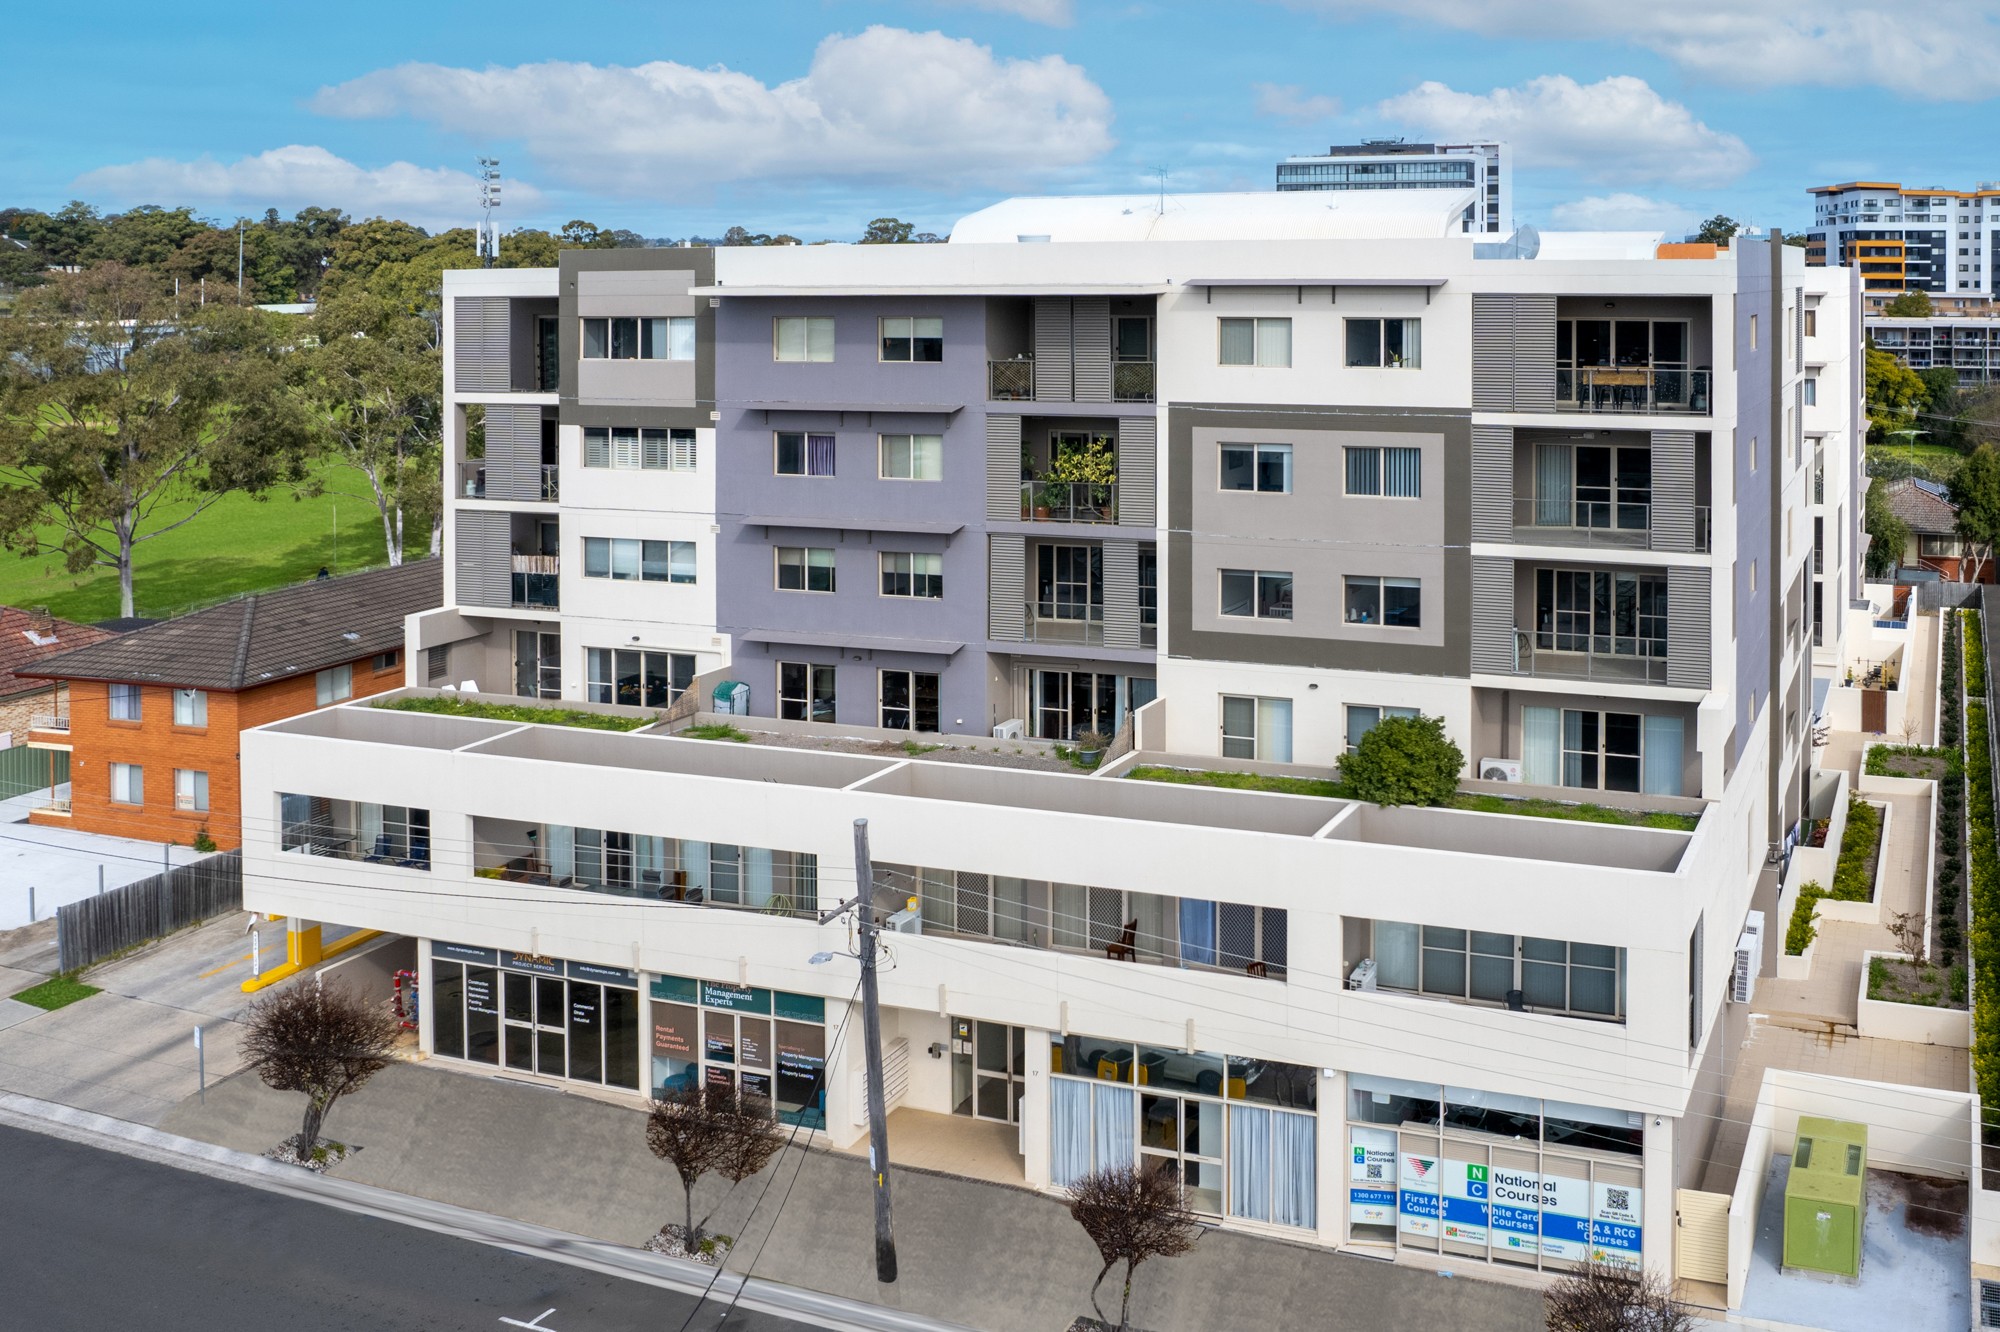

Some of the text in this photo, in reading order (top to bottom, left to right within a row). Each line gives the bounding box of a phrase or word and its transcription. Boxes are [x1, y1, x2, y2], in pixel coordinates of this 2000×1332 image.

[533, 964, 555, 972] SERVICES
[706, 980, 719, 988] The
[705, 986, 753, 1001] Management
[705, 995, 733, 1007] Experts
[655, 1025, 674, 1033] Rental
[655, 1033, 684, 1043] Payments
[655, 1041, 690, 1052] Guaranteed
[781, 1051, 824, 1062] Property Management
[781, 1060, 798, 1069] Property
[781, 1069, 814, 1080] Property Leasing
[1472, 1167, 1483, 1180] N
[1494, 1173, 1557, 1193] National
[1471, 1183, 1483, 1196] C
[1404, 1192, 1428, 1205] First
[1430, 1198, 1449, 1209] Ad
[1495, 1186, 1558, 1207] Courses
[1364, 1209, 1383, 1217] Google
[1480, 1204, 1539, 1222] White Card
[1410, 1219, 1429, 1228] Google
[1492, 1216, 1534, 1231] Courses
[1458, 1228, 1476, 1236] National
[1577, 1220, 1636, 1239] RSA & RCG
[1584, 1232, 1629, 1247] Courses
[1542, 1243, 1565, 1251] ospitality
[1543, 1246, 1563, 1254] Courses
